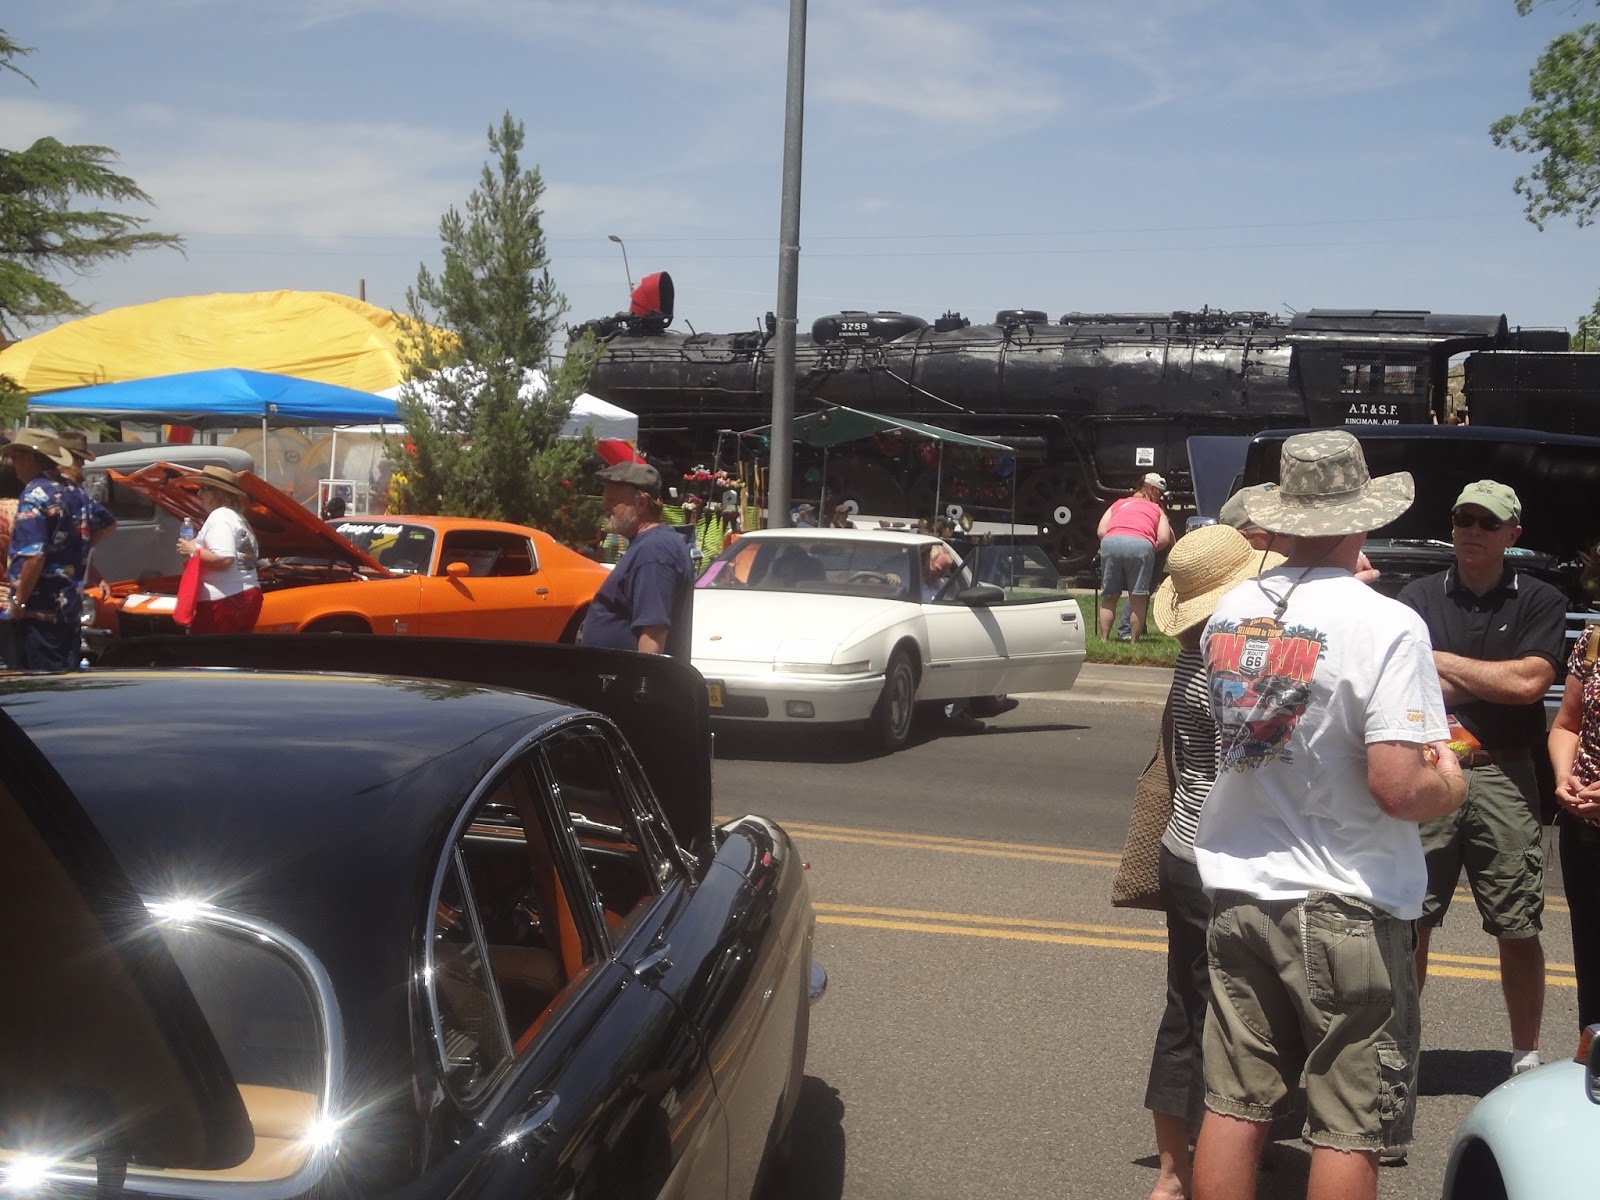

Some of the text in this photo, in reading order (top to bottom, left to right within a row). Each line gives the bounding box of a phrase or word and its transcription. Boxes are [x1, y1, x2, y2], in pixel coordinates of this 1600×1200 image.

[841, 322, 868, 331] 3759
[335, 522, 403, 535] Orange Crush
[1245, 656, 1262, 667] 66
[1259, 637, 1322, 684] RUN
